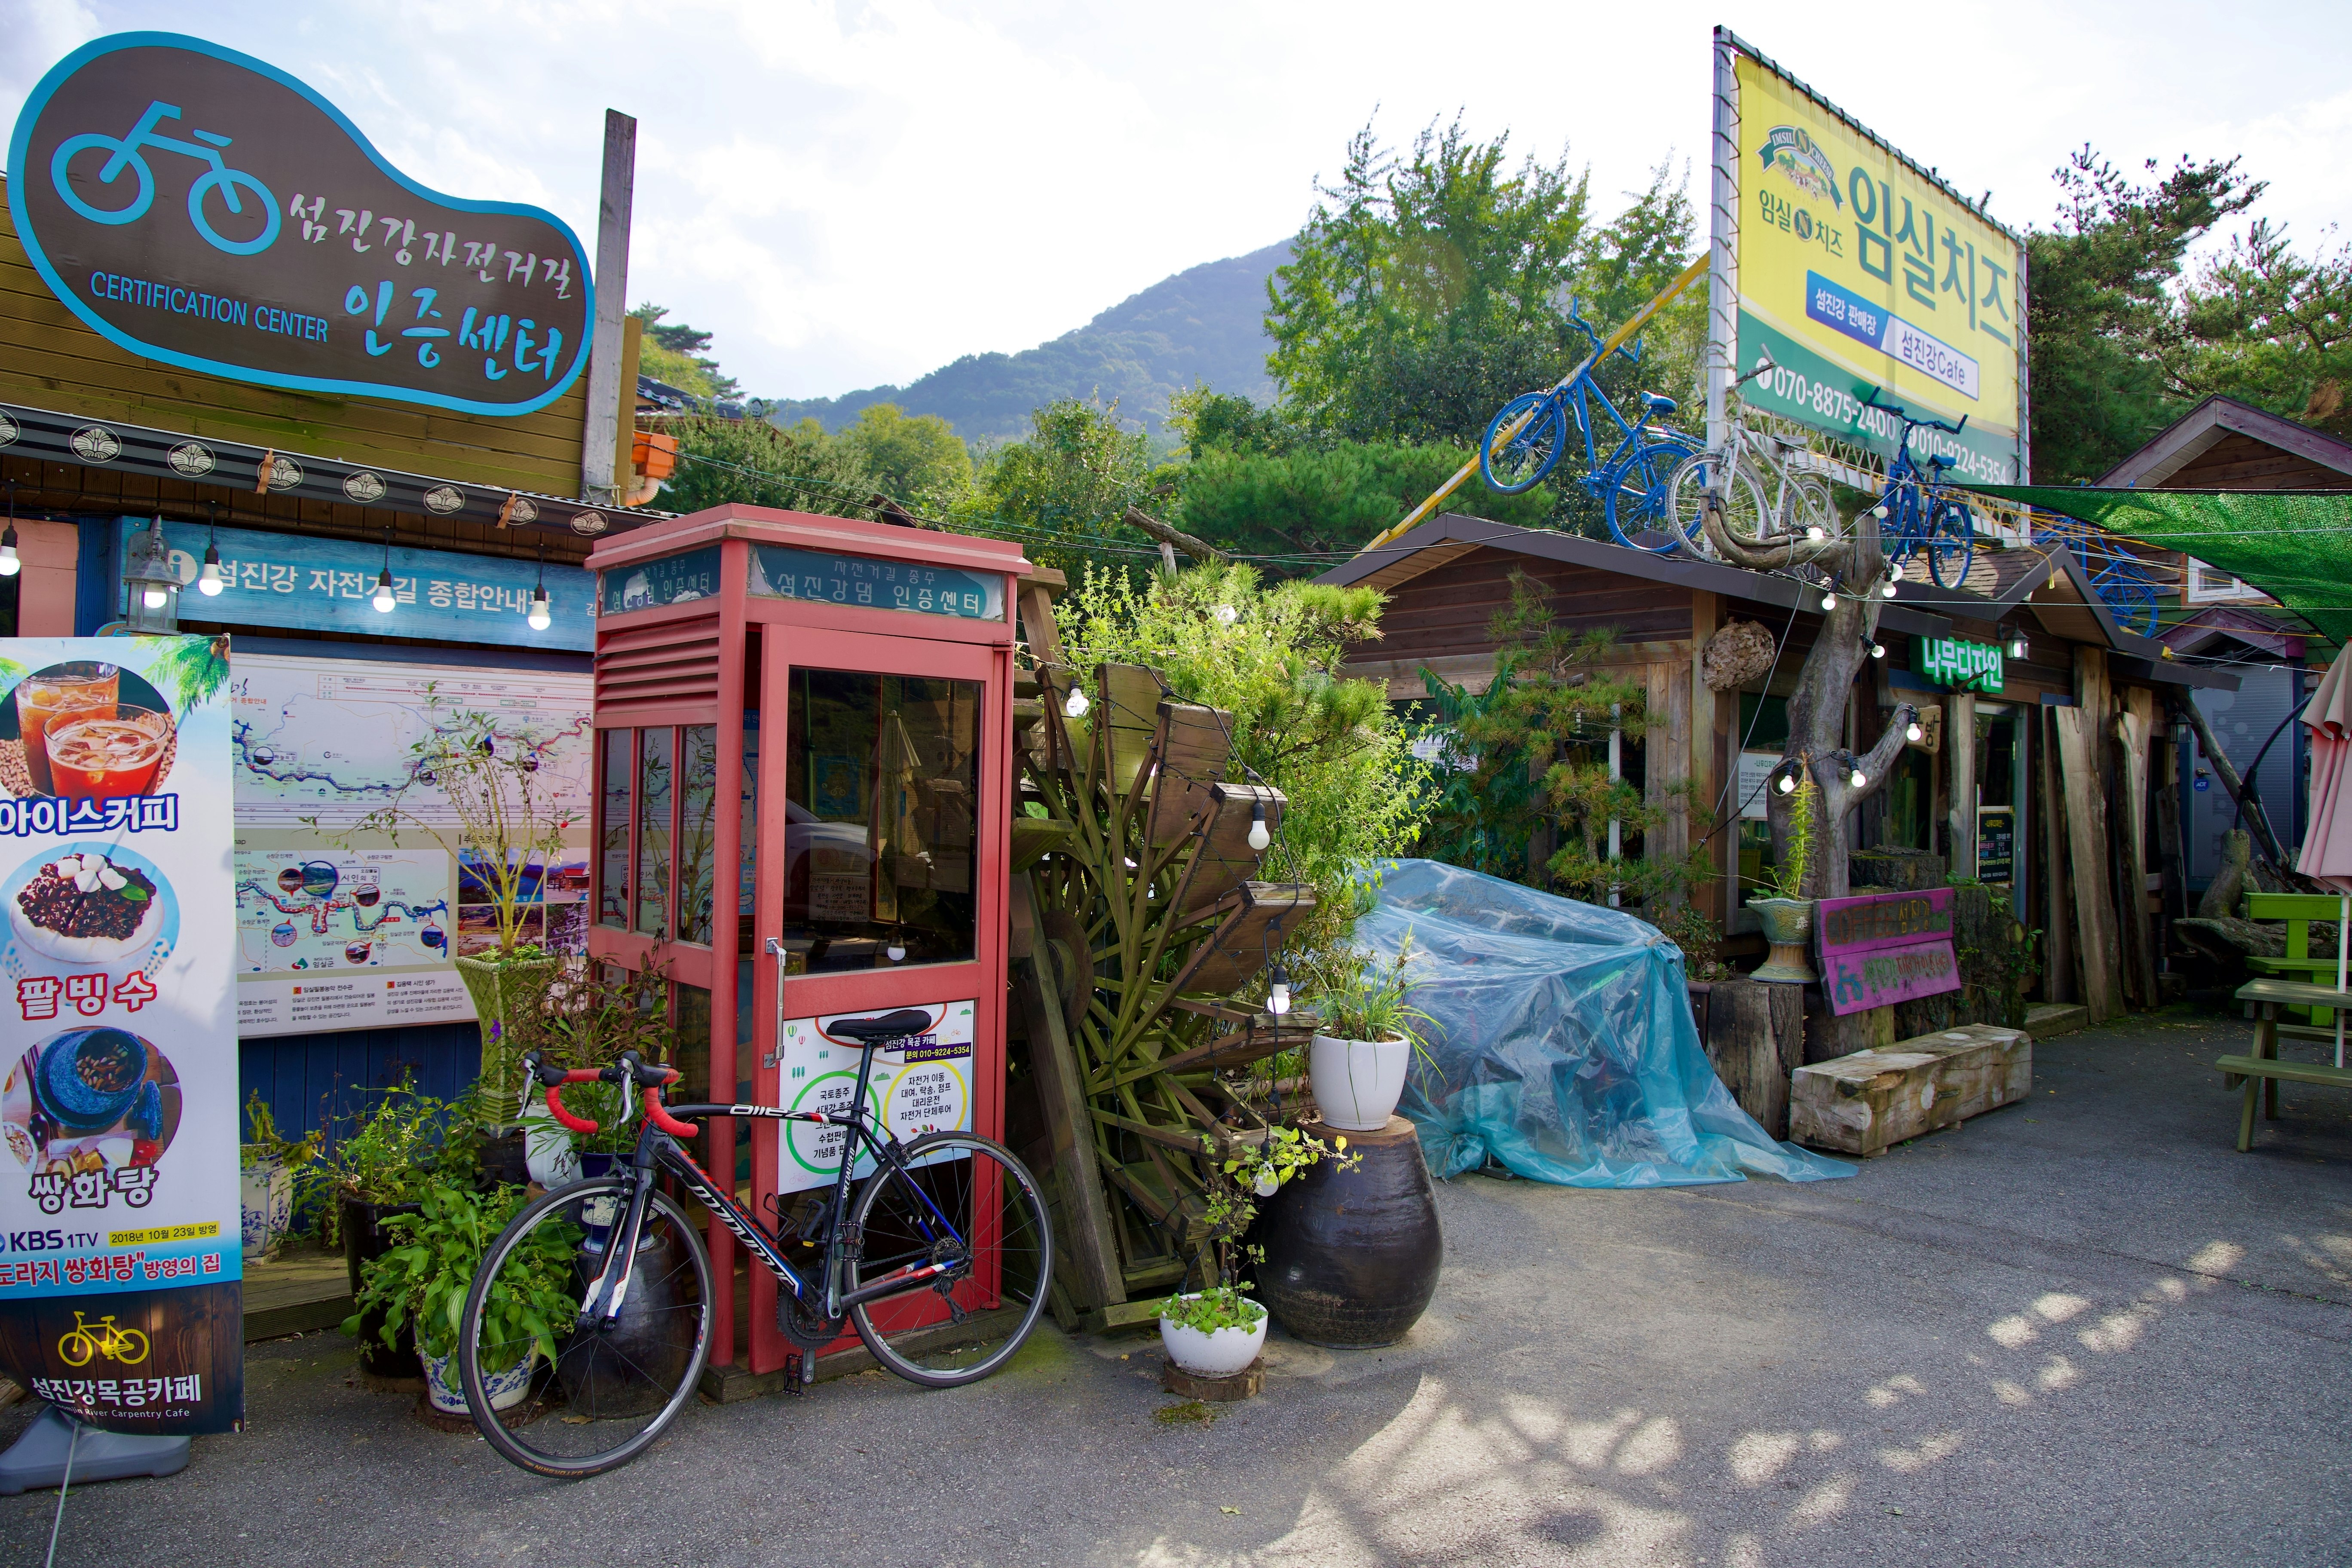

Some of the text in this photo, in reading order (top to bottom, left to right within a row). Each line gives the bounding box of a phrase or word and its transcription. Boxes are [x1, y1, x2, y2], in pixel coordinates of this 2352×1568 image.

[1771, 132, 1794, 147] IMSIL
[1811, 147, 1833, 181] CHEESE
[1759, 189, 1791, 233] 임실
[1815, 220, 1843, 258] 치즈
[290, 193, 571, 300] 섬진강자전거길
[1849, 166, 2011, 346] 임실치즈
[91, 271, 328, 343] CERTIFICATION CENTER
[1815, 288, 1877, 337] 섬진강 판매장
[345, 280, 563, 381] 인증센터
[1774, 366, 2007, 484] 070-8875-2400 010-9224-5354
[217, 560, 299, 593] 섬진강
[671, 559, 686, 575] 종주
[834, 560, 935, 585] 자전거길 종주
[612, 583, 654, 610] 섬진강댐
[777, 573, 979, 614] 섬진강댐 인증센터
[1923, 637, 2003, 688] 나무디자인
[0, 794, 177, 836] 아이스커피
[340, 874, 366, 883] 시인의
[1826, 902, 1895, 946] COFFEE
[1899, 900, 1930, 934] 섬진강
[1864, 958, 1899, 993] 섬진강
[18, 972, 156, 1020] 팔빙수
[884, 1034, 936, 1049] 섬진강 목공 카페
[905, 1045, 970, 1060] 문의 010-9224-5354
[900, 1083, 952, 1098] 대여, 탁송, 점프
[908, 1072, 945, 1086] 자전거 이동
[820, 1087, 850, 1100] 국토종주
[912, 1096, 940, 1108] 대리운전
[729, 1104, 806, 1119] allez
[815, 1103, 836, 1116] 4대강
[900, 1104, 952, 1121] 자전거 단체투어
[813, 1146, 836, 1158] 기념품
[976, 1137, 1013, 1158] GATORSKIN
[842, 1147, 855, 1203] SPECIALIZED
[30, 1166, 158, 1213] 쌍화탕
[650, 1203, 667, 1215] IMANO
[9, 1229, 98, 1252] KBS 1TV
[111, 1224, 217, 1244] 2018년 10월 23일 방영
[144, 1256, 196, 1279] 방영의
[202, 1253, 220, 1274] 집
[32, 1374, 202, 1406] 섬진강목공카페
[52, 1401, 190, 1419] Seomjin River Carpentry Cafe
[534, 1464, 584, 1476] GATORSKIN
